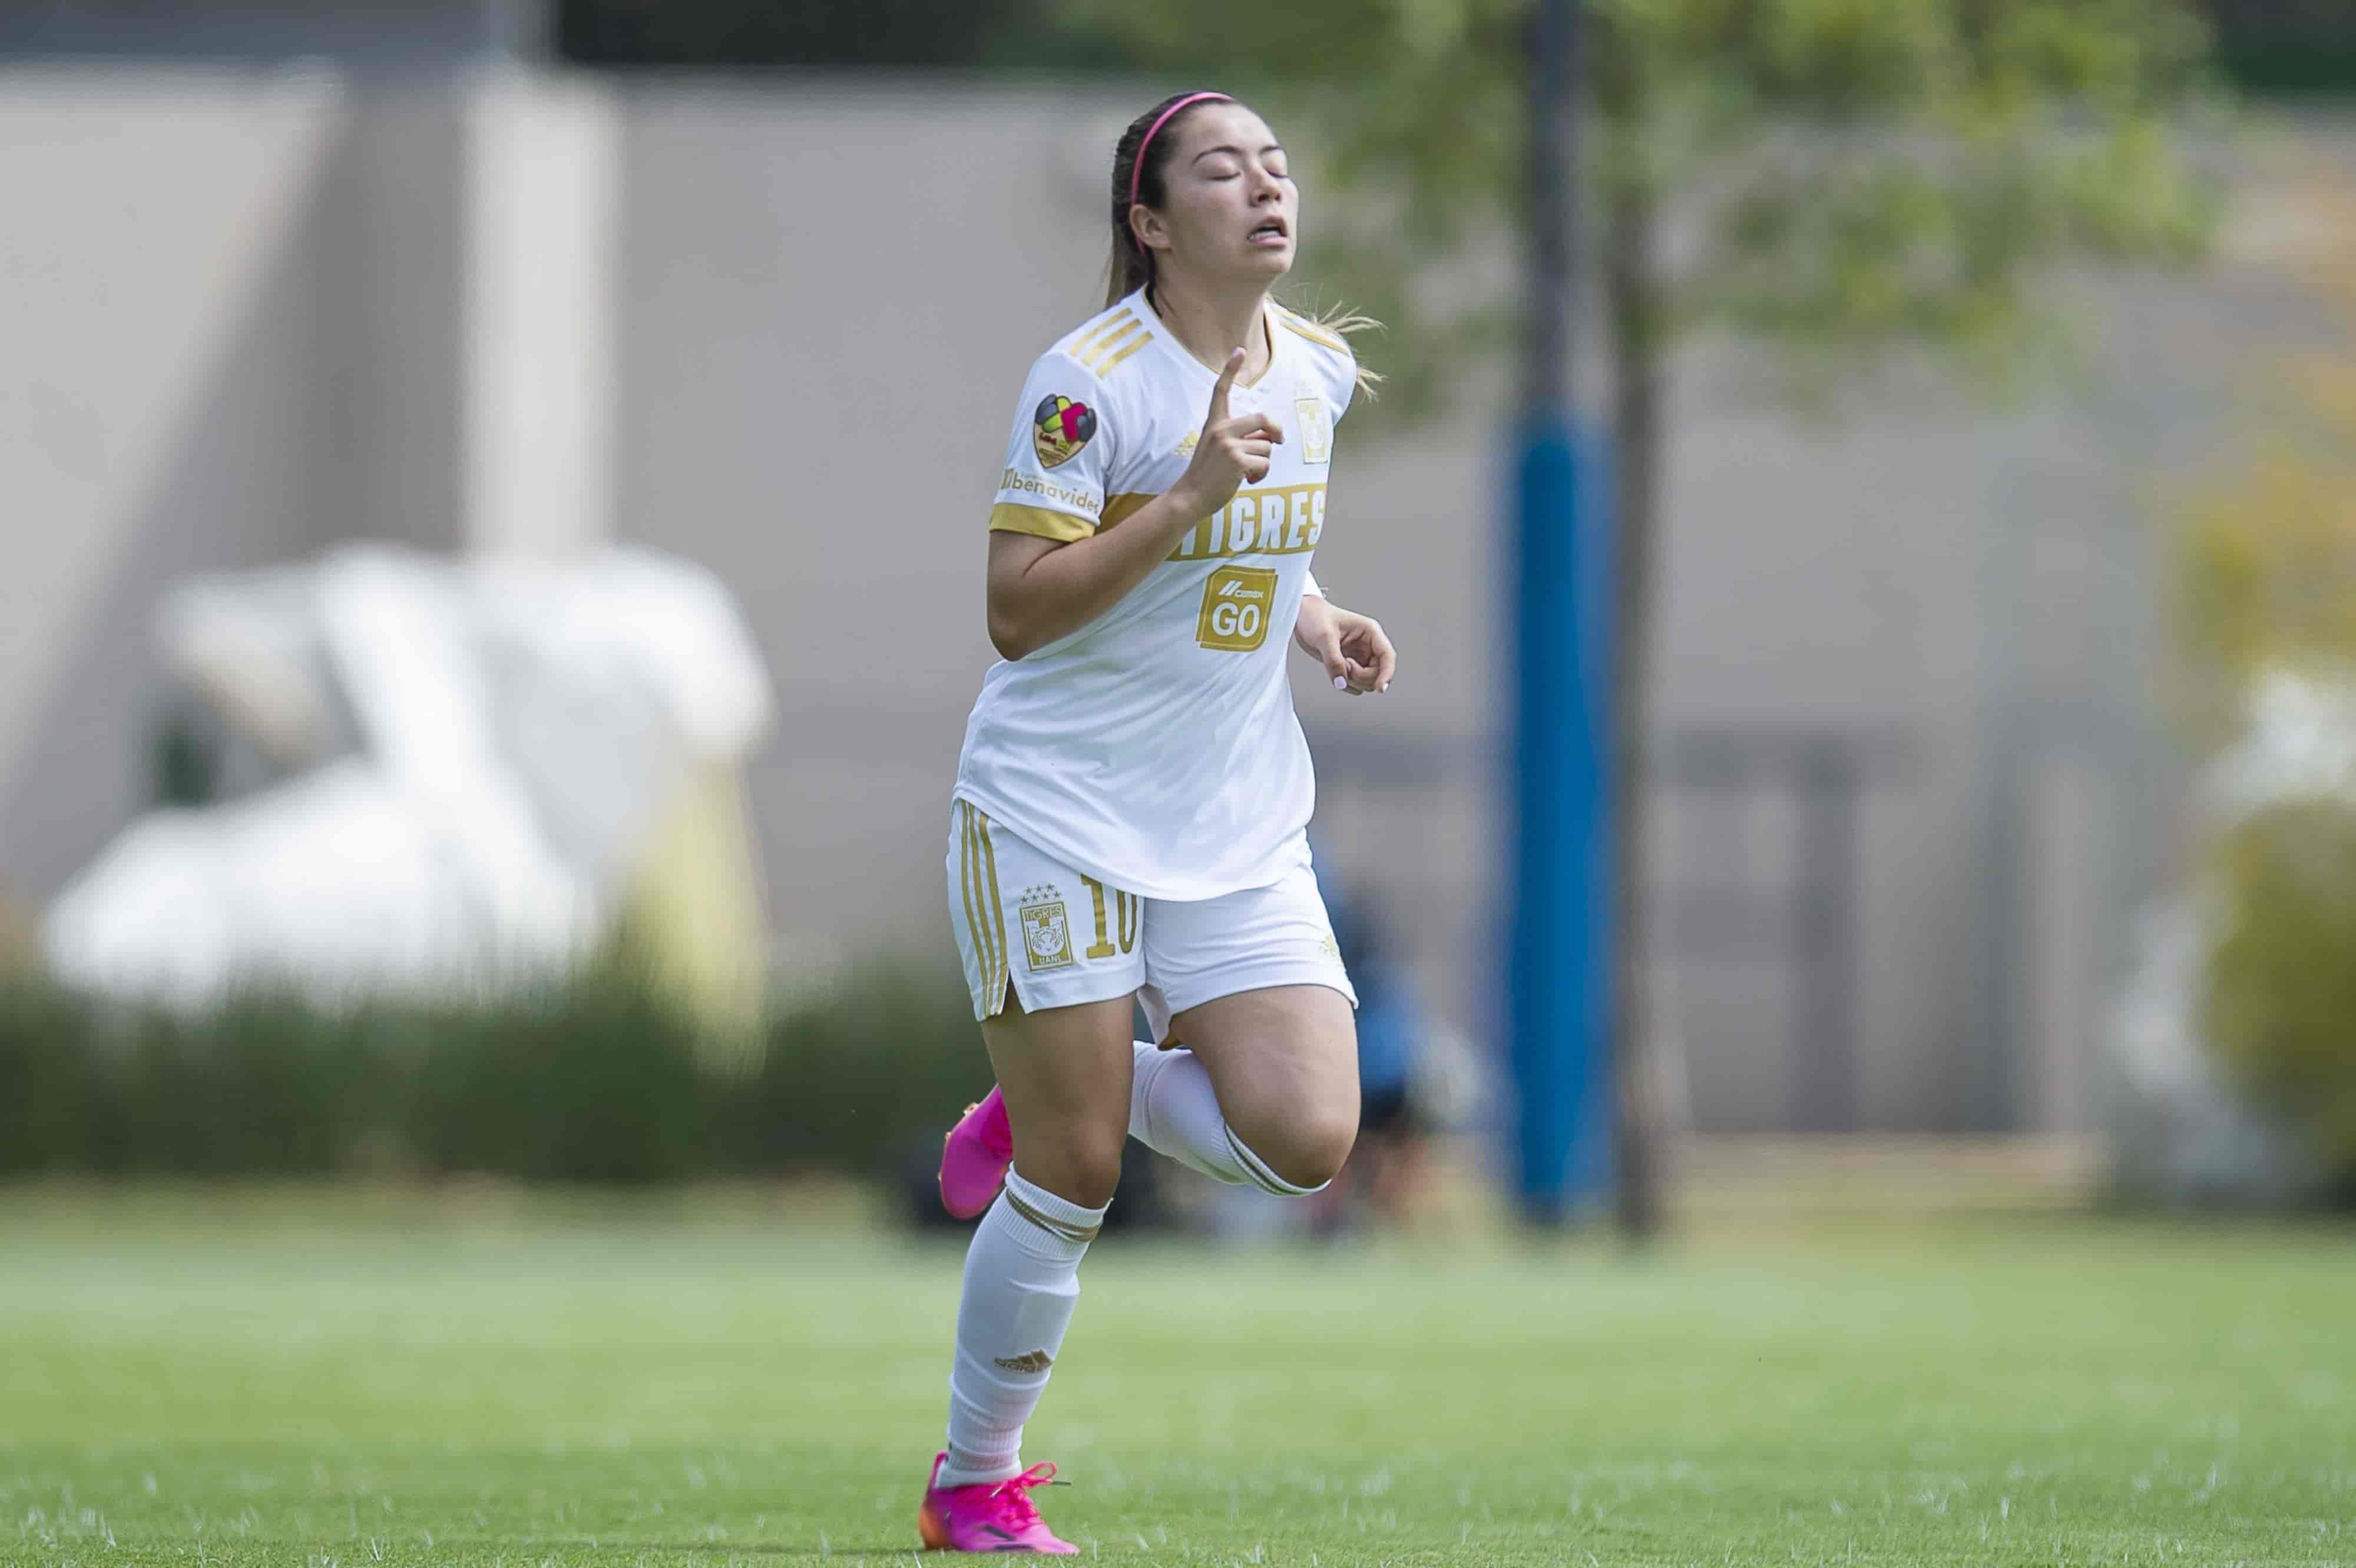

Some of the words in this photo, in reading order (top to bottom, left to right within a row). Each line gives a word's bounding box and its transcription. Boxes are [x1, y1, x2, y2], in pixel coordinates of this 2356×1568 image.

[1212, 603, 1260, 637] GO
[1024, 905, 1062, 921] TIGRES
[1080, 873, 1137, 959] 10
